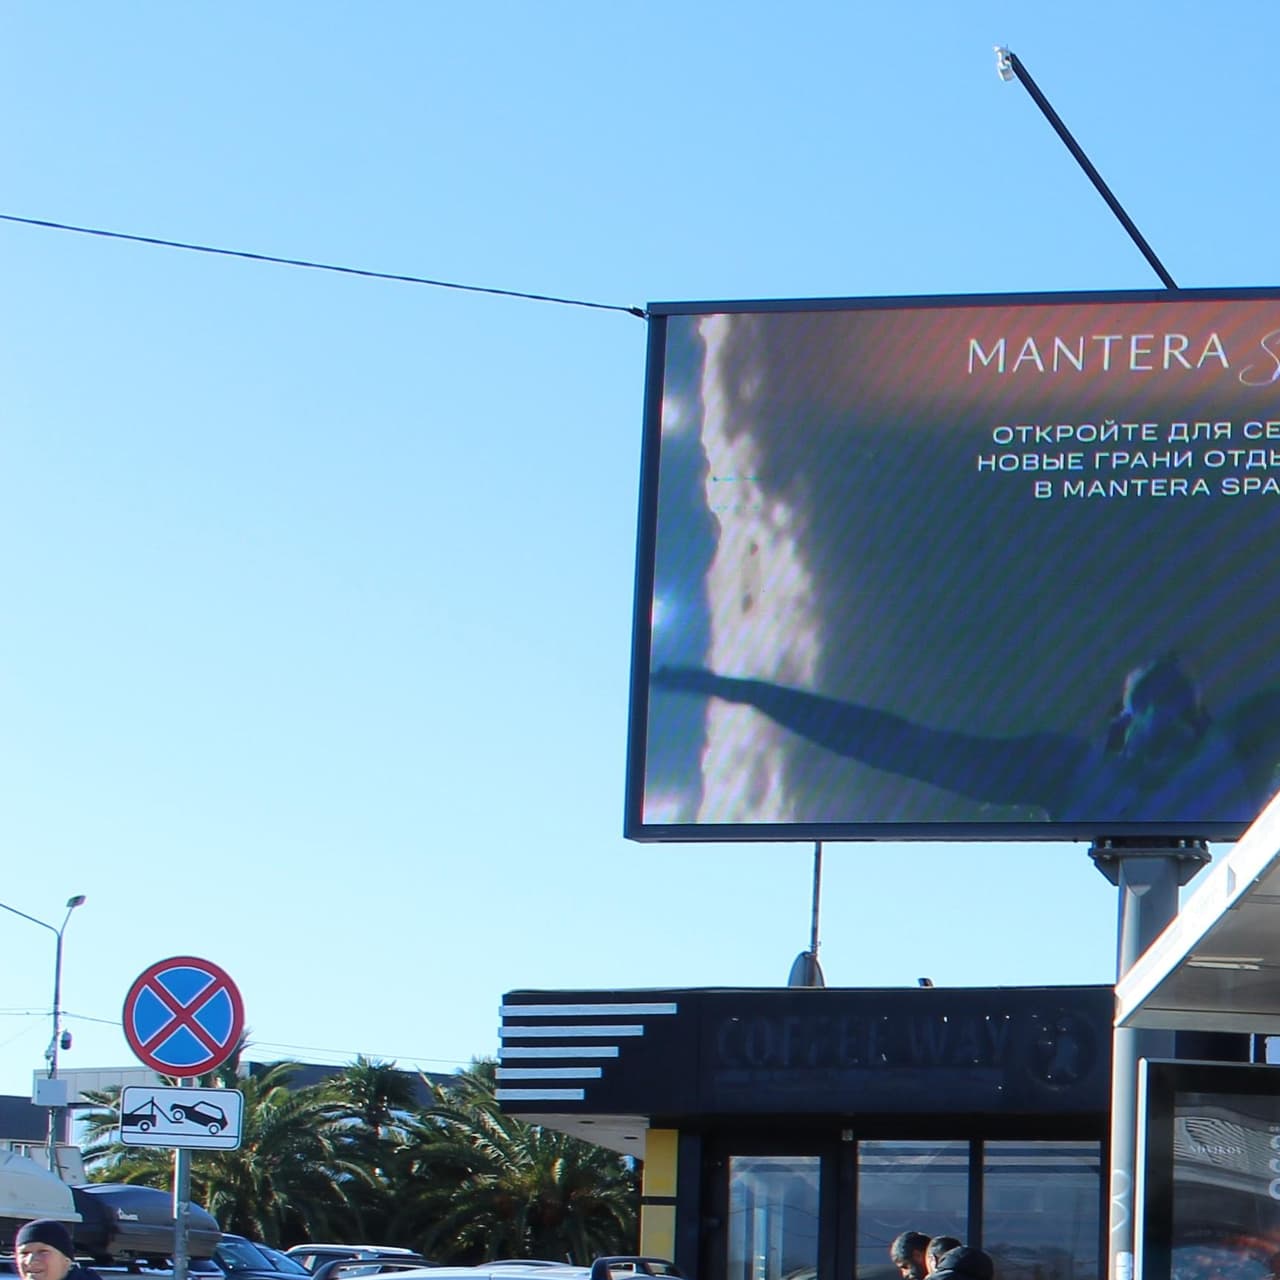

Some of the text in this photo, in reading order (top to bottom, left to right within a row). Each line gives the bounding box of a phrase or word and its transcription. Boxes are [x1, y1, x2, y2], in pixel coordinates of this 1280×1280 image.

[968, 332, 1230, 374] MANTERA
[992, 419, 1158, 445] ОТКРОЙТЕ
[1168, 422, 1232, 445] ДЛЯ
[977, 452, 1084, 472] НОВЫЕ
[1094, 450, 1194, 471] ГРАНИ
[1063, 478, 1211, 498] MANTERA
